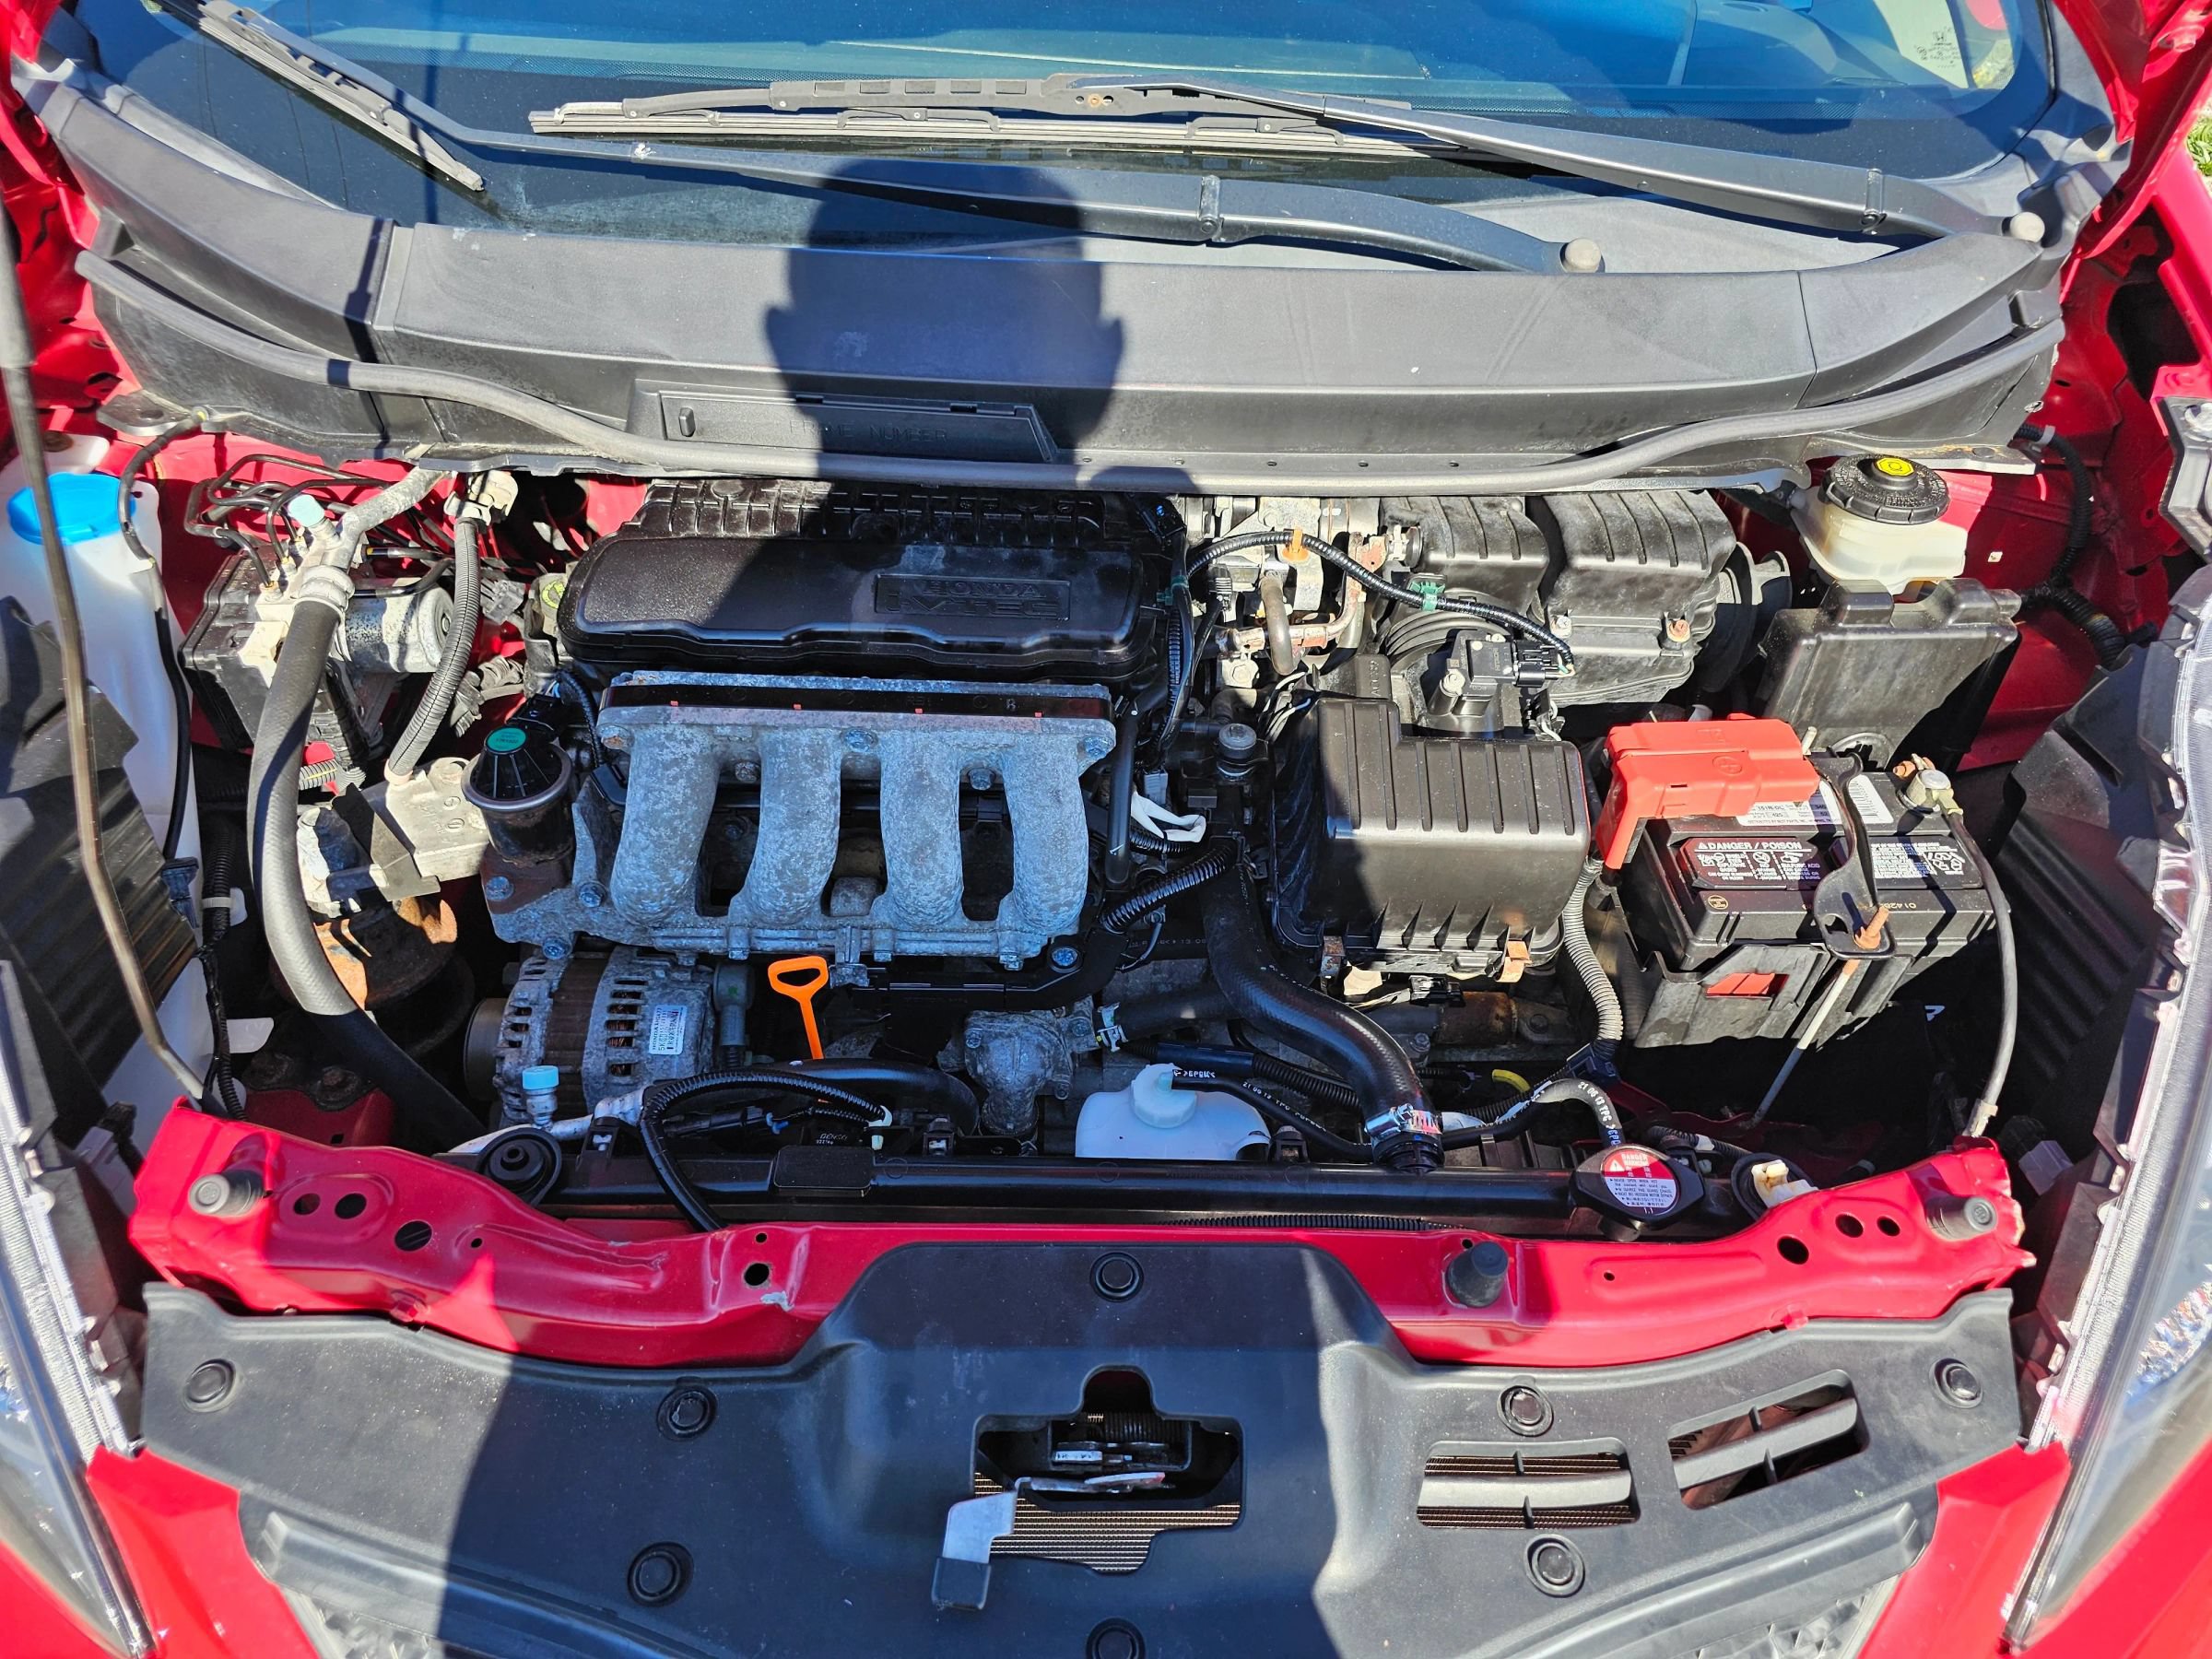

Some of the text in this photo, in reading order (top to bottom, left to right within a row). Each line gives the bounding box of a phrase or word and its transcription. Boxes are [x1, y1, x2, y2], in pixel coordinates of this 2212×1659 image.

[870, 422, 947, 443] NUMBER
[922, 579, 1047, 599] HONDA
[1762, 841, 1803, 850] POISON
[1578, 1081, 1589, 1089] 21
[1599, 1105, 1612, 1122] TPC
